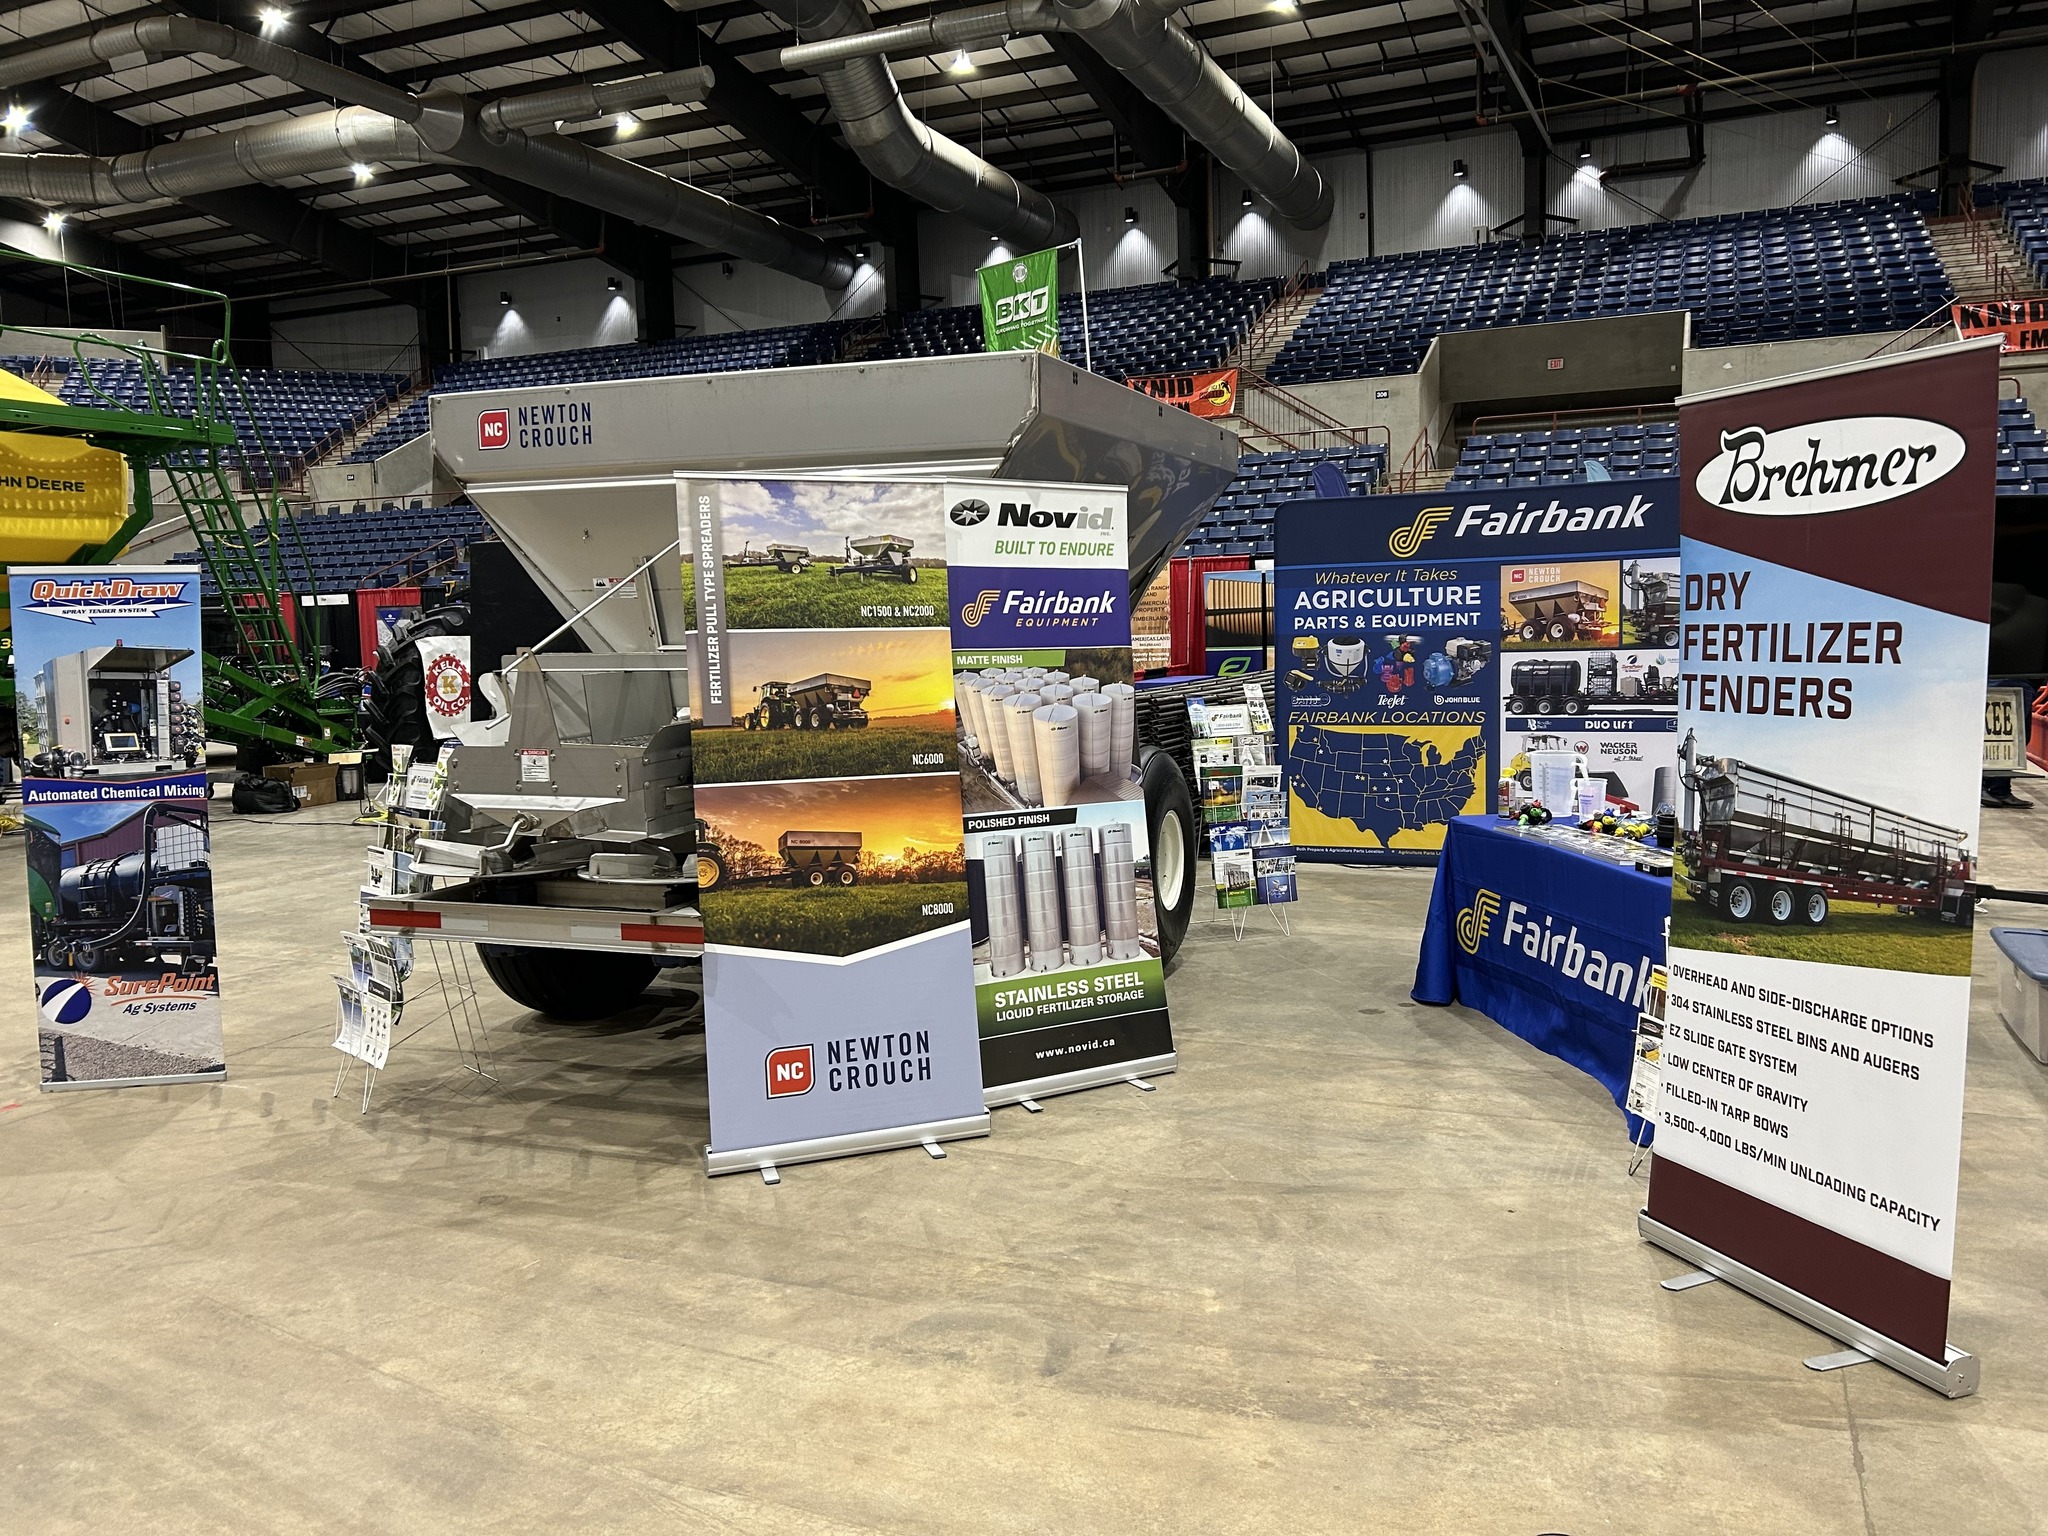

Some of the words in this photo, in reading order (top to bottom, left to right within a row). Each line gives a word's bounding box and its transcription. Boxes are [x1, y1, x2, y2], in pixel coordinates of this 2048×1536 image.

[995, 286, 1049, 327] BKT
[995, 324, 1020, 335] GROWING
[1020, 316, 1048, 328] TOGETHER
[518, 402, 592, 425] NEWTON
[484, 421, 503, 437] NC
[519, 424, 593, 449] CROUCH
[1718, 431, 1938, 505] Brehmer
[26, 476, 85, 492] DEERE
[1455, 494, 1655, 538] Fairbank
[698, 495, 715, 569] SPREADERS
[994, 540, 1036, 555] BUILT
[1038, 541, 1056, 555] TO
[1059, 542, 1115, 556] ENDURE
[1315, 570, 1390, 585] Whatever
[1395, 569, 1407, 582] It
[1413, 568, 1458, 581] Takes
[1528, 567, 1561, 575] NEWTON
[1528, 574, 1561, 583] CROUCH
[32, 578, 184, 602] QuickDraw
[702, 570, 717, 602] TYPE
[1294, 585, 1482, 611] AGRICULTURE
[1684, 571, 1752, 612] DRY
[61, 608, 87, 616] SPRAY
[88, 608, 117, 616] TENDER
[118, 607, 148, 615] SYSTEM
[861, 605, 892, 617] NC1500
[894, 606, 901, 617] &
[902, 605, 935, 617] NC2000
[1002, 590, 1117, 615] Fairbank
[705, 603, 720, 635] PULL
[1015, 617, 1099, 627] EQUIPMENT
[1294, 616, 1349, 630] PARTS
[1354, 615, 1366, 628] &
[1371, 612, 1481, 628] EQUIPMENT
[1683, 621, 1903, 665] FERTILIZER
[707, 636, 723, 705] FERTILIZER
[956, 656, 989, 665] MATTE
[991, 655, 1023, 665] FINISH
[441, 675, 458, 694] K
[1681, 673, 1853, 720] TENDERS
[433, 695, 450, 712] OIL
[1377, 694, 1408, 709] TeeJet
[1288, 711, 1378, 723] FAIRBANK
[1381, 711, 1487, 723] LOCATIONS
[1585, 720, 1611, 729] DUO
[1613, 720, 1634, 729] LIFT
[912, 753, 944, 766] NC6000
[28, 790, 97, 802] Automated
[101, 787, 160, 799] Chemical
[164, 784, 205, 798] Mixing
[968, 816, 1016, 830] POLISHED
[1018, 814, 1050, 826] FINISH
[921, 902, 954, 916] NC8000
[1503, 900, 1650, 1014] Fairbank
[104, 972, 215, 996] SurePoint
[994, 979, 1090, 1008] STAINLESS
[1094, 971, 1144, 991] STEEL
[123, 1003, 142, 1016] Ag
[143, 1001, 197, 1014] Systems
[996, 1007, 1035, 1022] LIQUID
[1036, 998, 1095, 1016] FERTILIZER
[1096, 989, 1145, 1007] STORAGE
[1672, 964, 1728, 991] OVERHEAD
[1731, 981, 1755, 999] AND
[1758, 988, 1867, 1030] SIDE-DISCHARGE
[1871, 1018, 1934, 1049] OPTIONS
[827, 1030, 931, 1065] NEWTON
[1035, 1038, 1116, 1060] www.novid.ca
[1671, 993, 1690, 1012] 304
[1692, 1001, 1753, 1030] STAINLESS
[1756, 1019, 1793, 1043] STEEL
[1796, 1031, 1828, 1053] BINS
[1830, 1042, 1860, 1062] AND
[1863, 1052, 1920, 1081] AUGERS
[1669, 1023, 1681, 1038] EZ
[1683, 1028, 1715, 1049] SLIDE
[1717, 1039, 1746, 1059] GATE
[1749, 1050, 1798, 1077] SYSTEM
[776, 1061, 804, 1082] NC
[828, 1056, 932, 1092] CROUCH
[1667, 1052, 1690, 1071] LOW
[1692, 1061, 1735, 1087] CENTER
[1738, 1077, 1754, 1093] OF
[1756, 1084, 1809, 1113] GRAVITY
[1666, 1082, 1718, 1112] FILLED-IN
[1721, 1101, 1750, 1124] TARP
[1753, 1114, 1789, 1139] BOWS
[1664, 1111, 1732, 1149] 3,500-4,000
[1735, 1138, 1787, 1172] LBS/MIN
[1790, 1160, 1867, 1203] UNLOADING
[1870, 1192, 1941, 1232] CAPACITY
